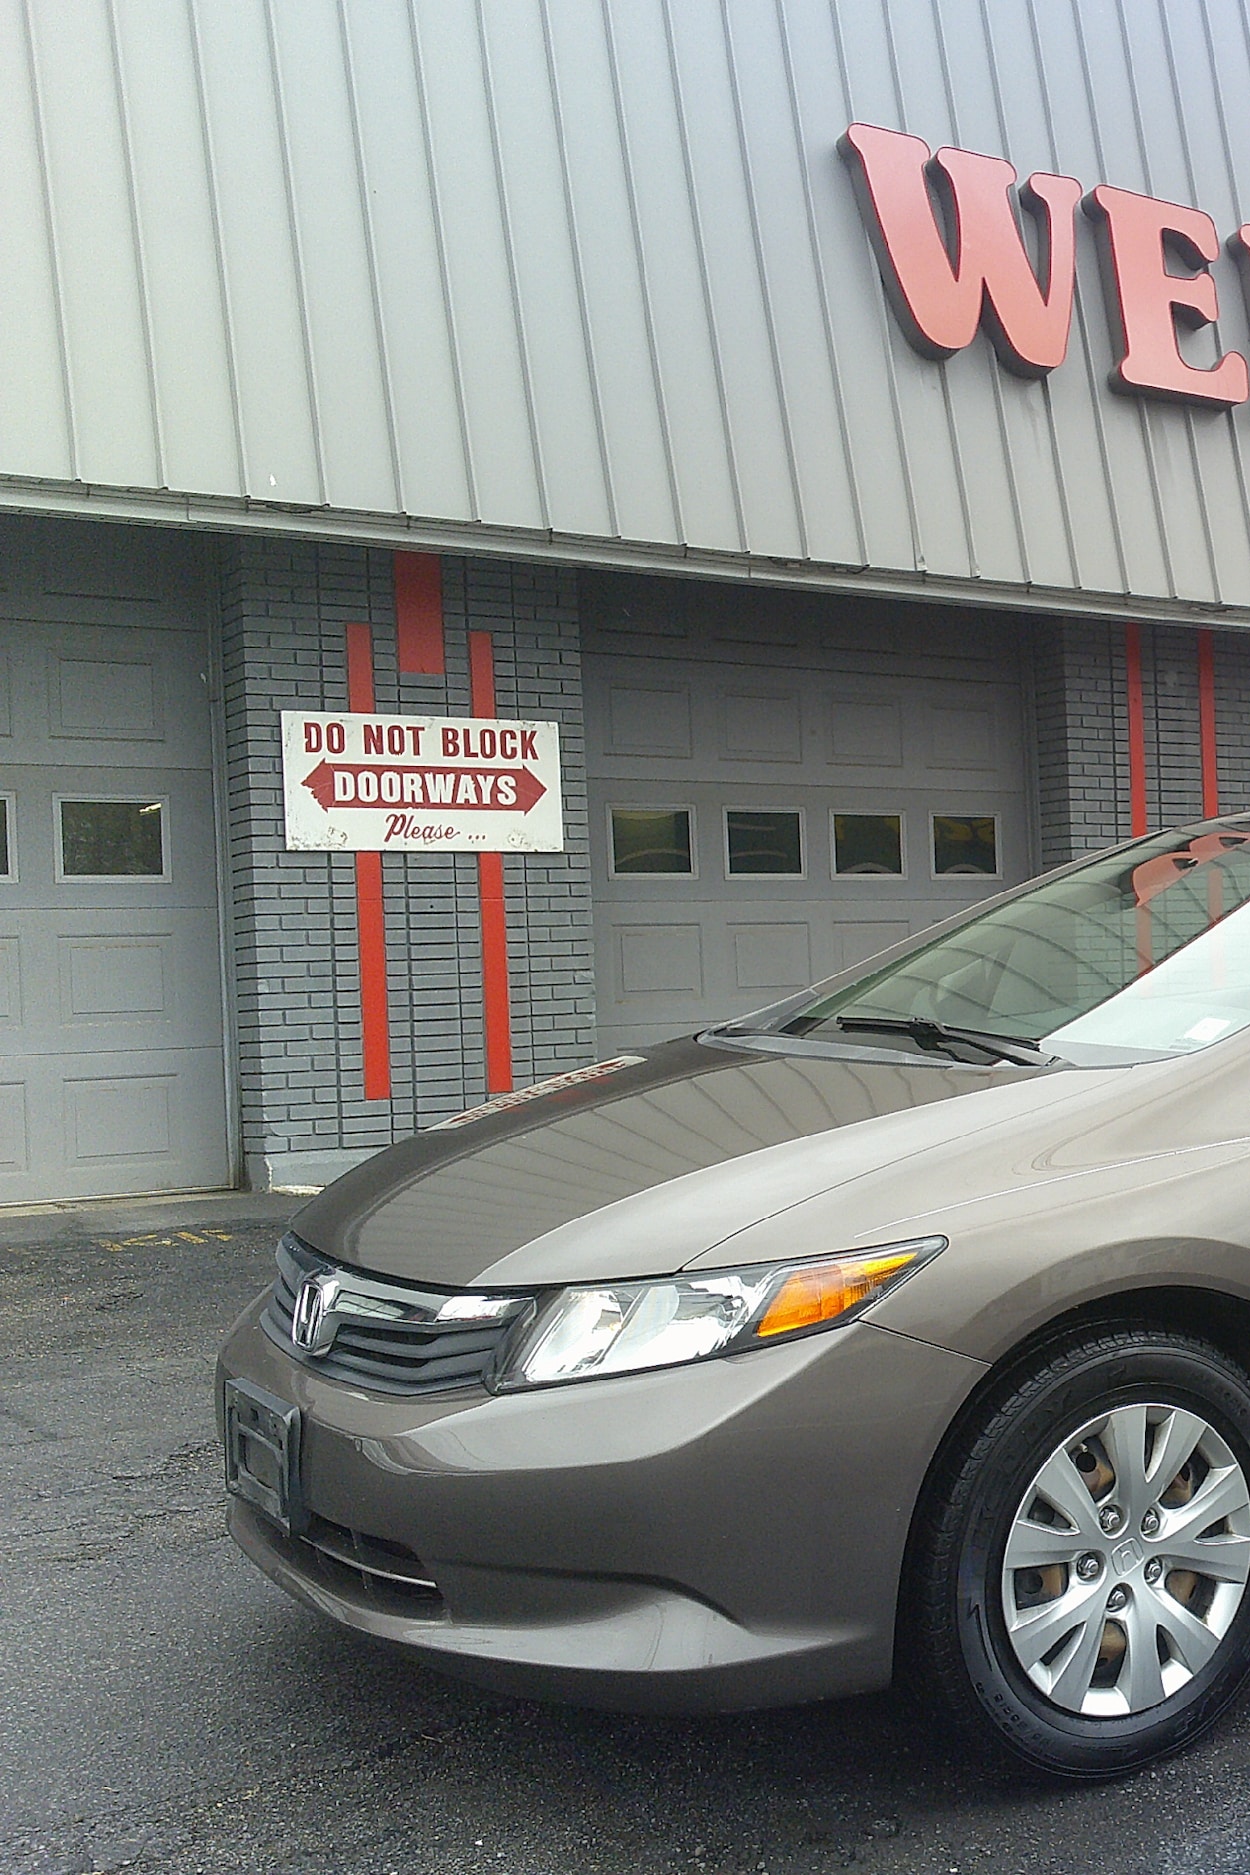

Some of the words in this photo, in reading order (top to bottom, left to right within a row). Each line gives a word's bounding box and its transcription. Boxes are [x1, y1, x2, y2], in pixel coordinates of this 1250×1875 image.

[303, 722, 346, 754] DO
[363, 724, 425, 756] NOT
[442, 727, 539, 760] BLOCK
[333, 770, 517, 806] DOORWAYS
